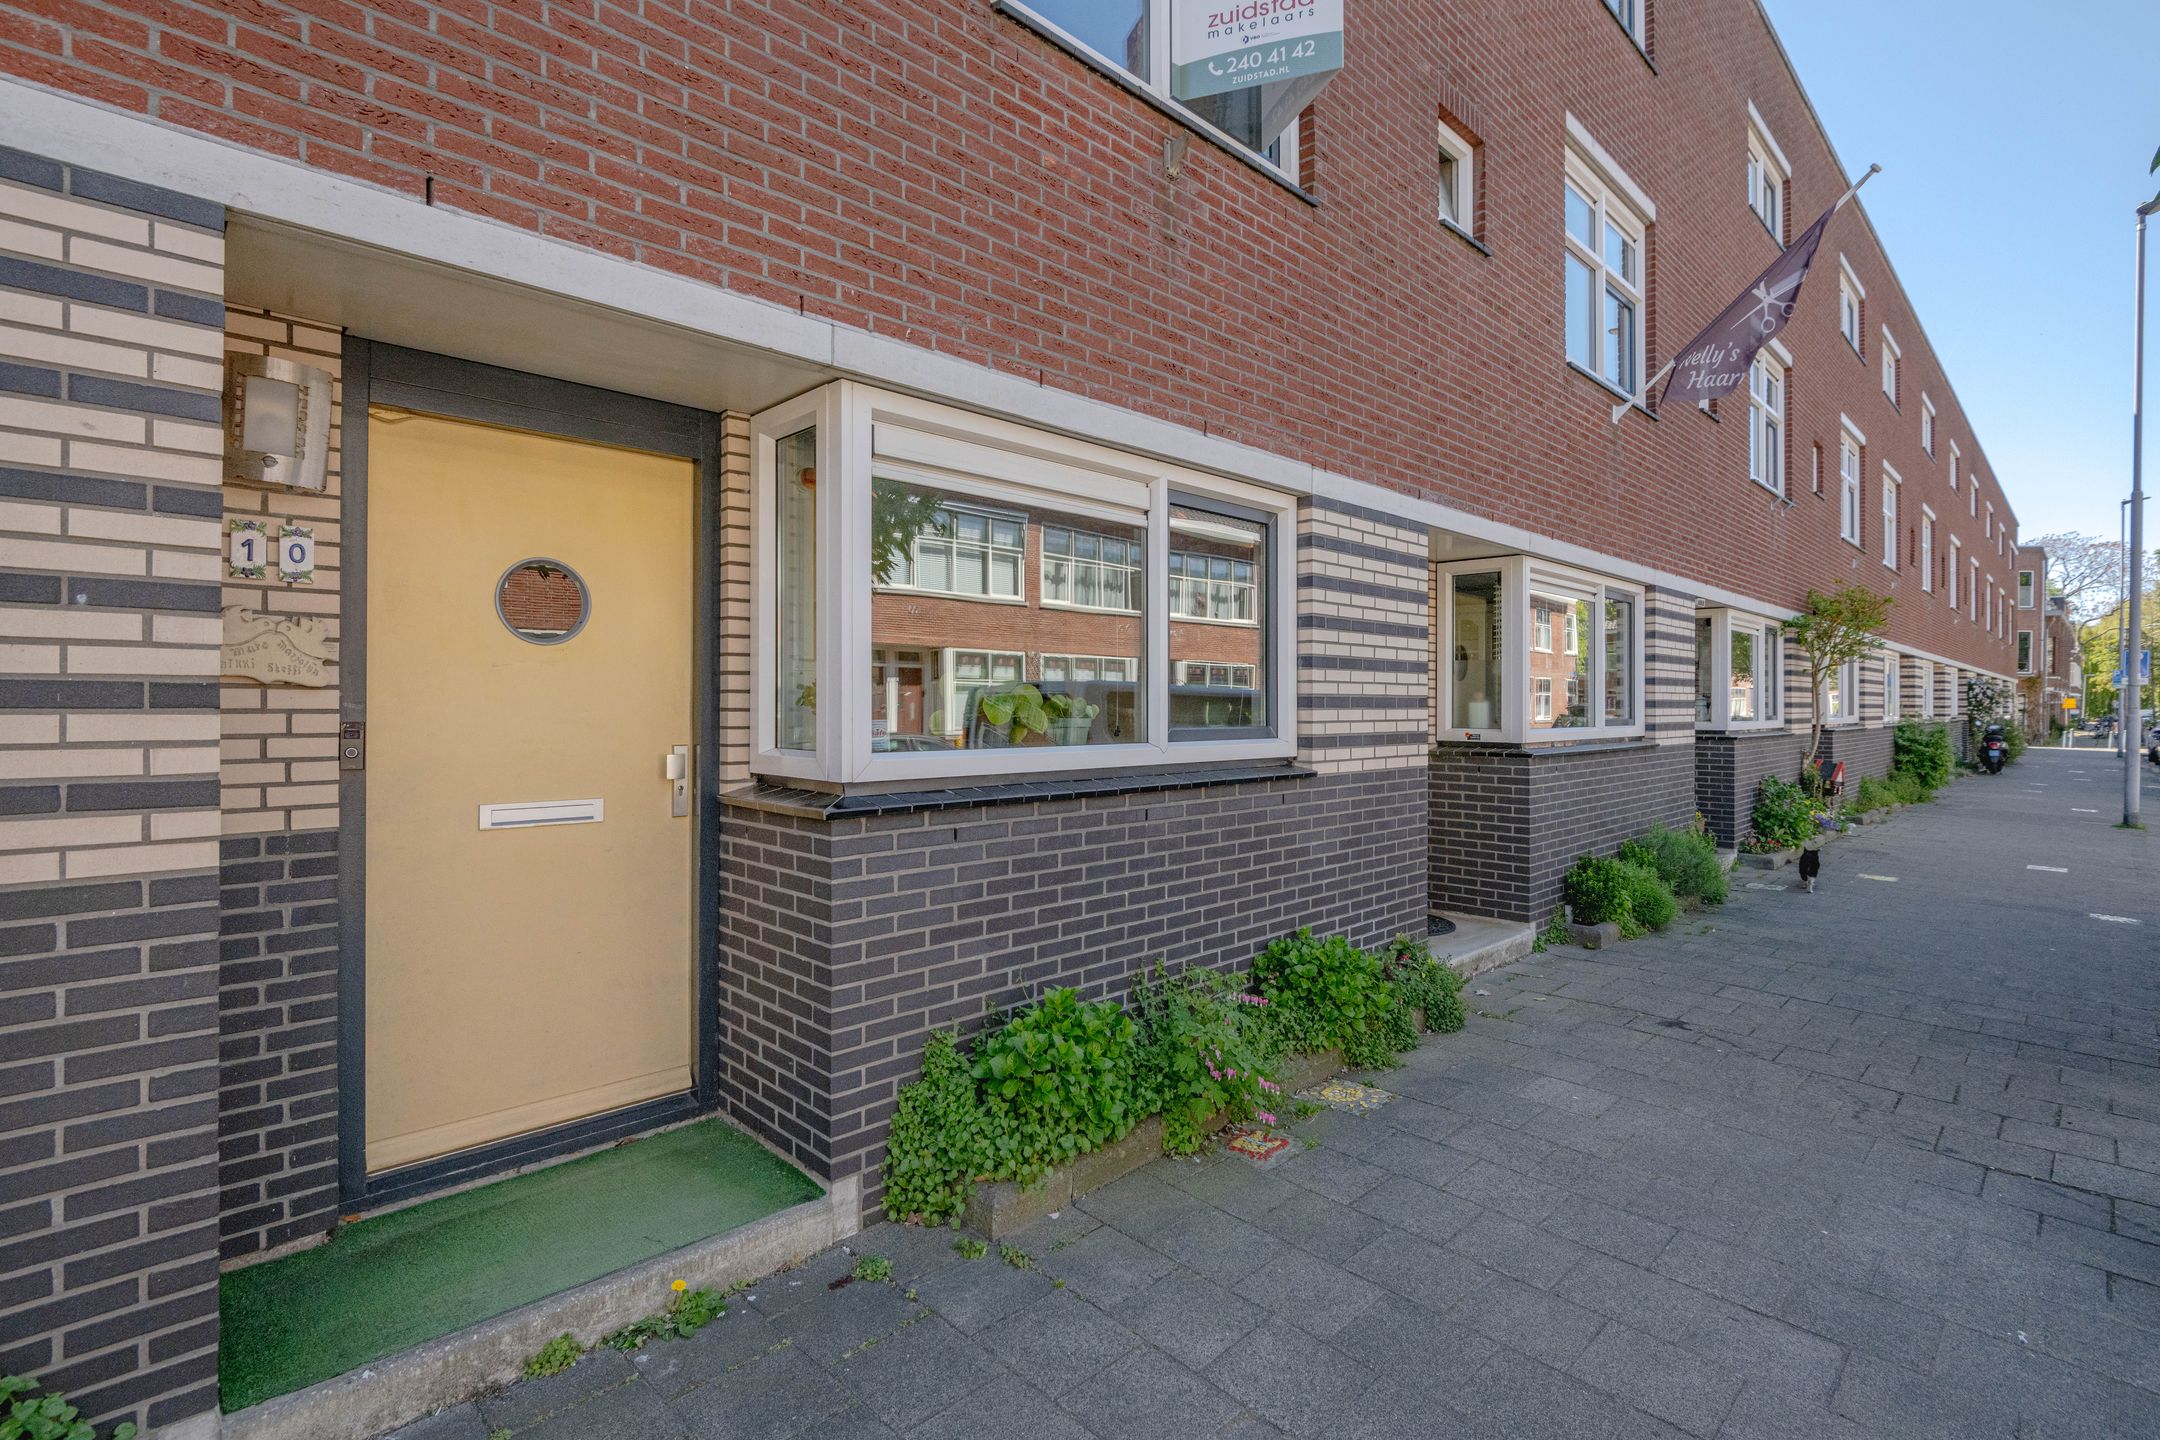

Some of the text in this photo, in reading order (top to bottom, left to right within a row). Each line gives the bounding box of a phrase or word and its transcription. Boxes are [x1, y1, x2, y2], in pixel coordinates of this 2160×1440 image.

[1208, 8, 1314, 39] makelaars
[1226, 40, 1316, 73] 240 41 42
[1232, 66, 1290, 84] ZUIDSTAD.NL
[1686, 369, 1745, 389] Haar
